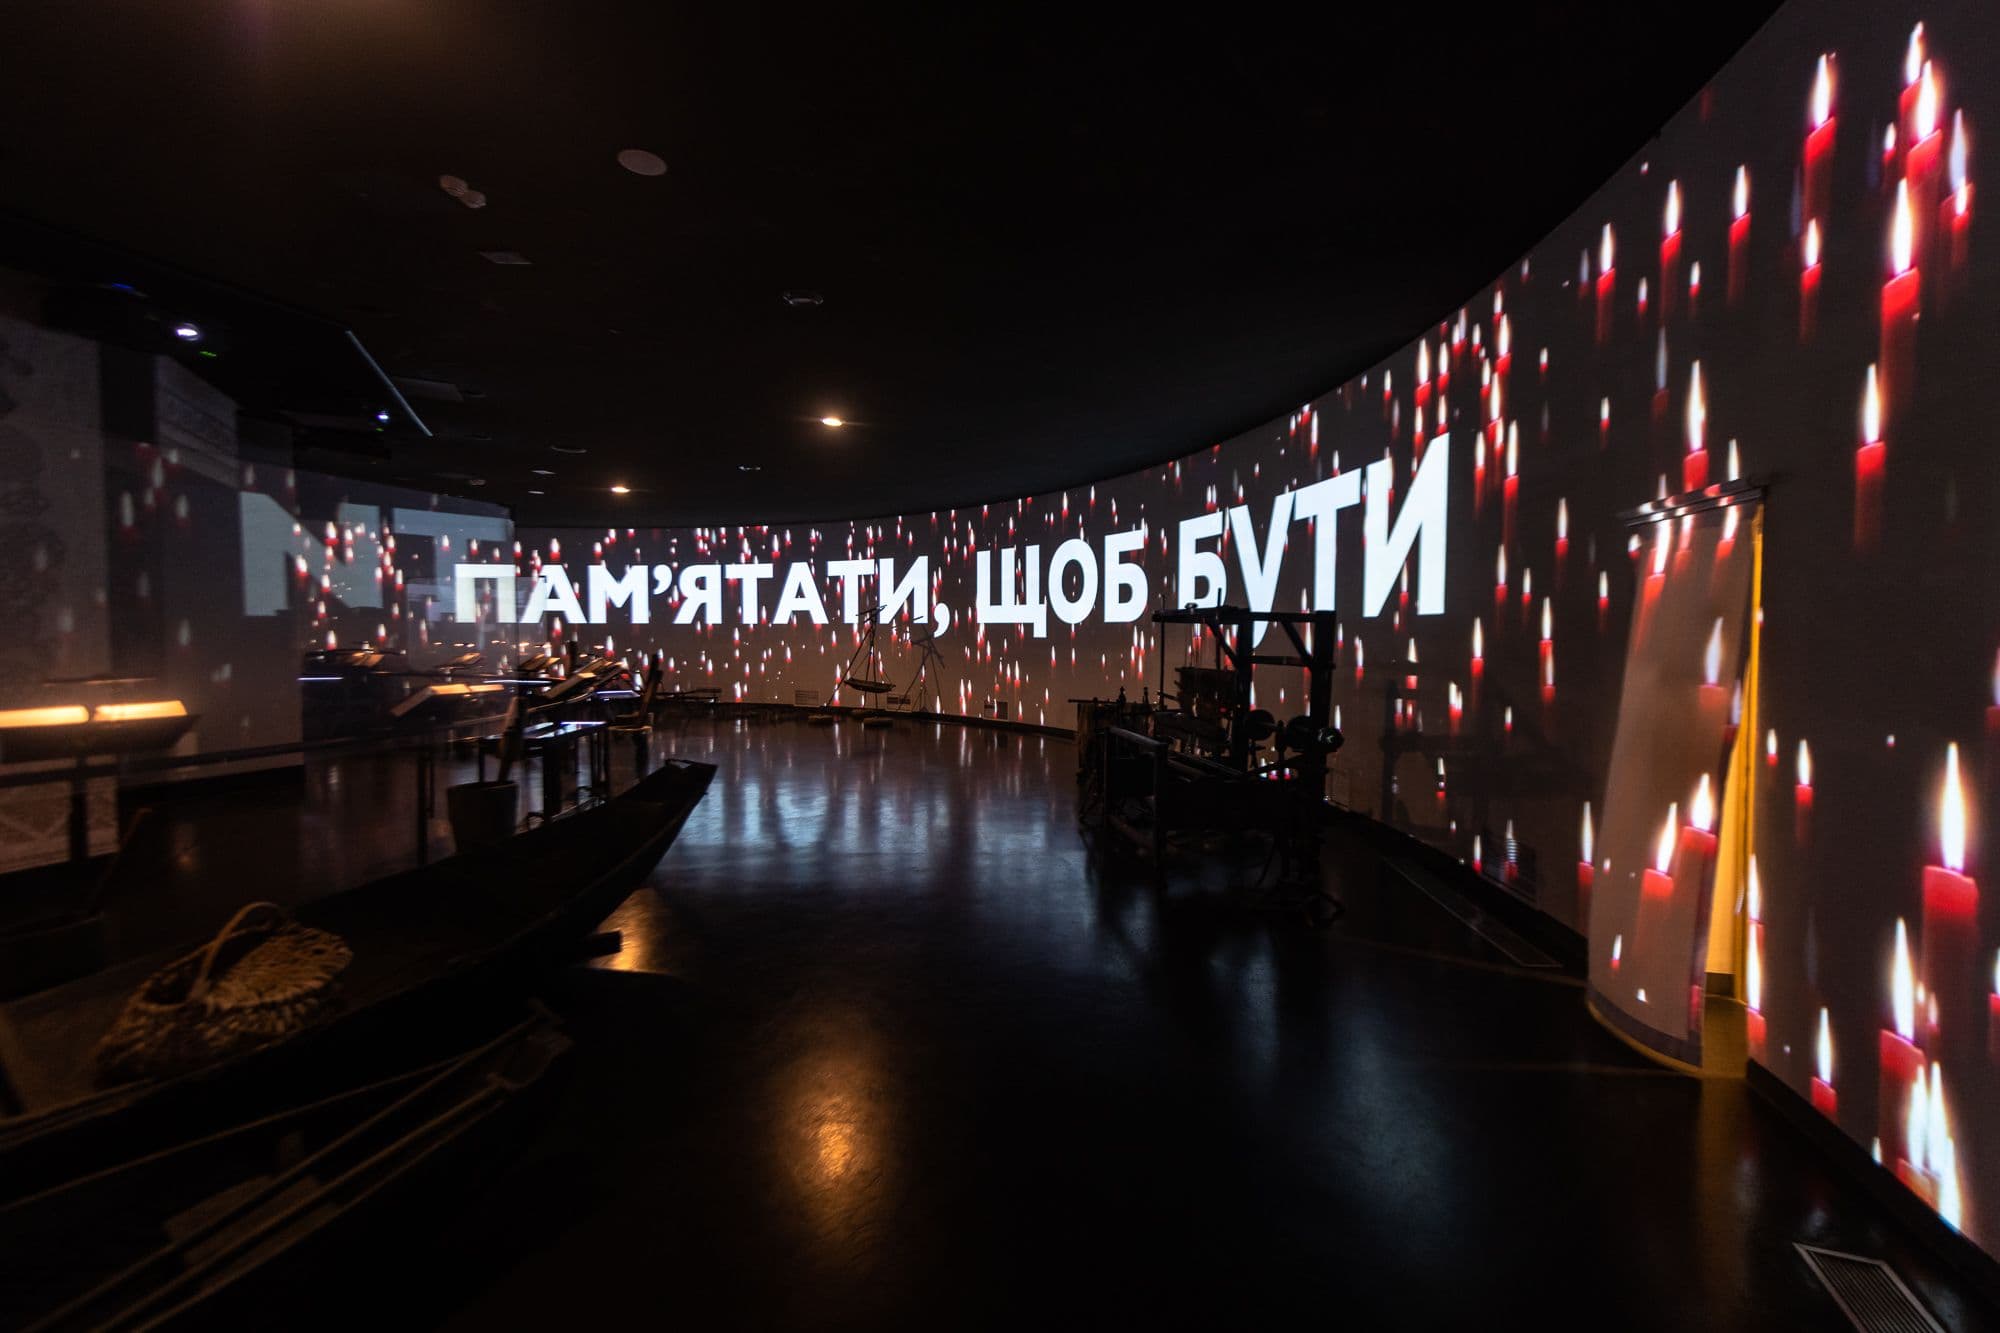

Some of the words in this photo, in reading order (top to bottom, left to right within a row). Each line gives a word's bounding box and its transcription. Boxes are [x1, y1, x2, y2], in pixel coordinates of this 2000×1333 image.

[455, 555, 949, 637] ПАМ’ЯТАТИ,
[976, 529, 1149, 638] ЩОБ
[1177, 433, 1450, 648] БУТИ
